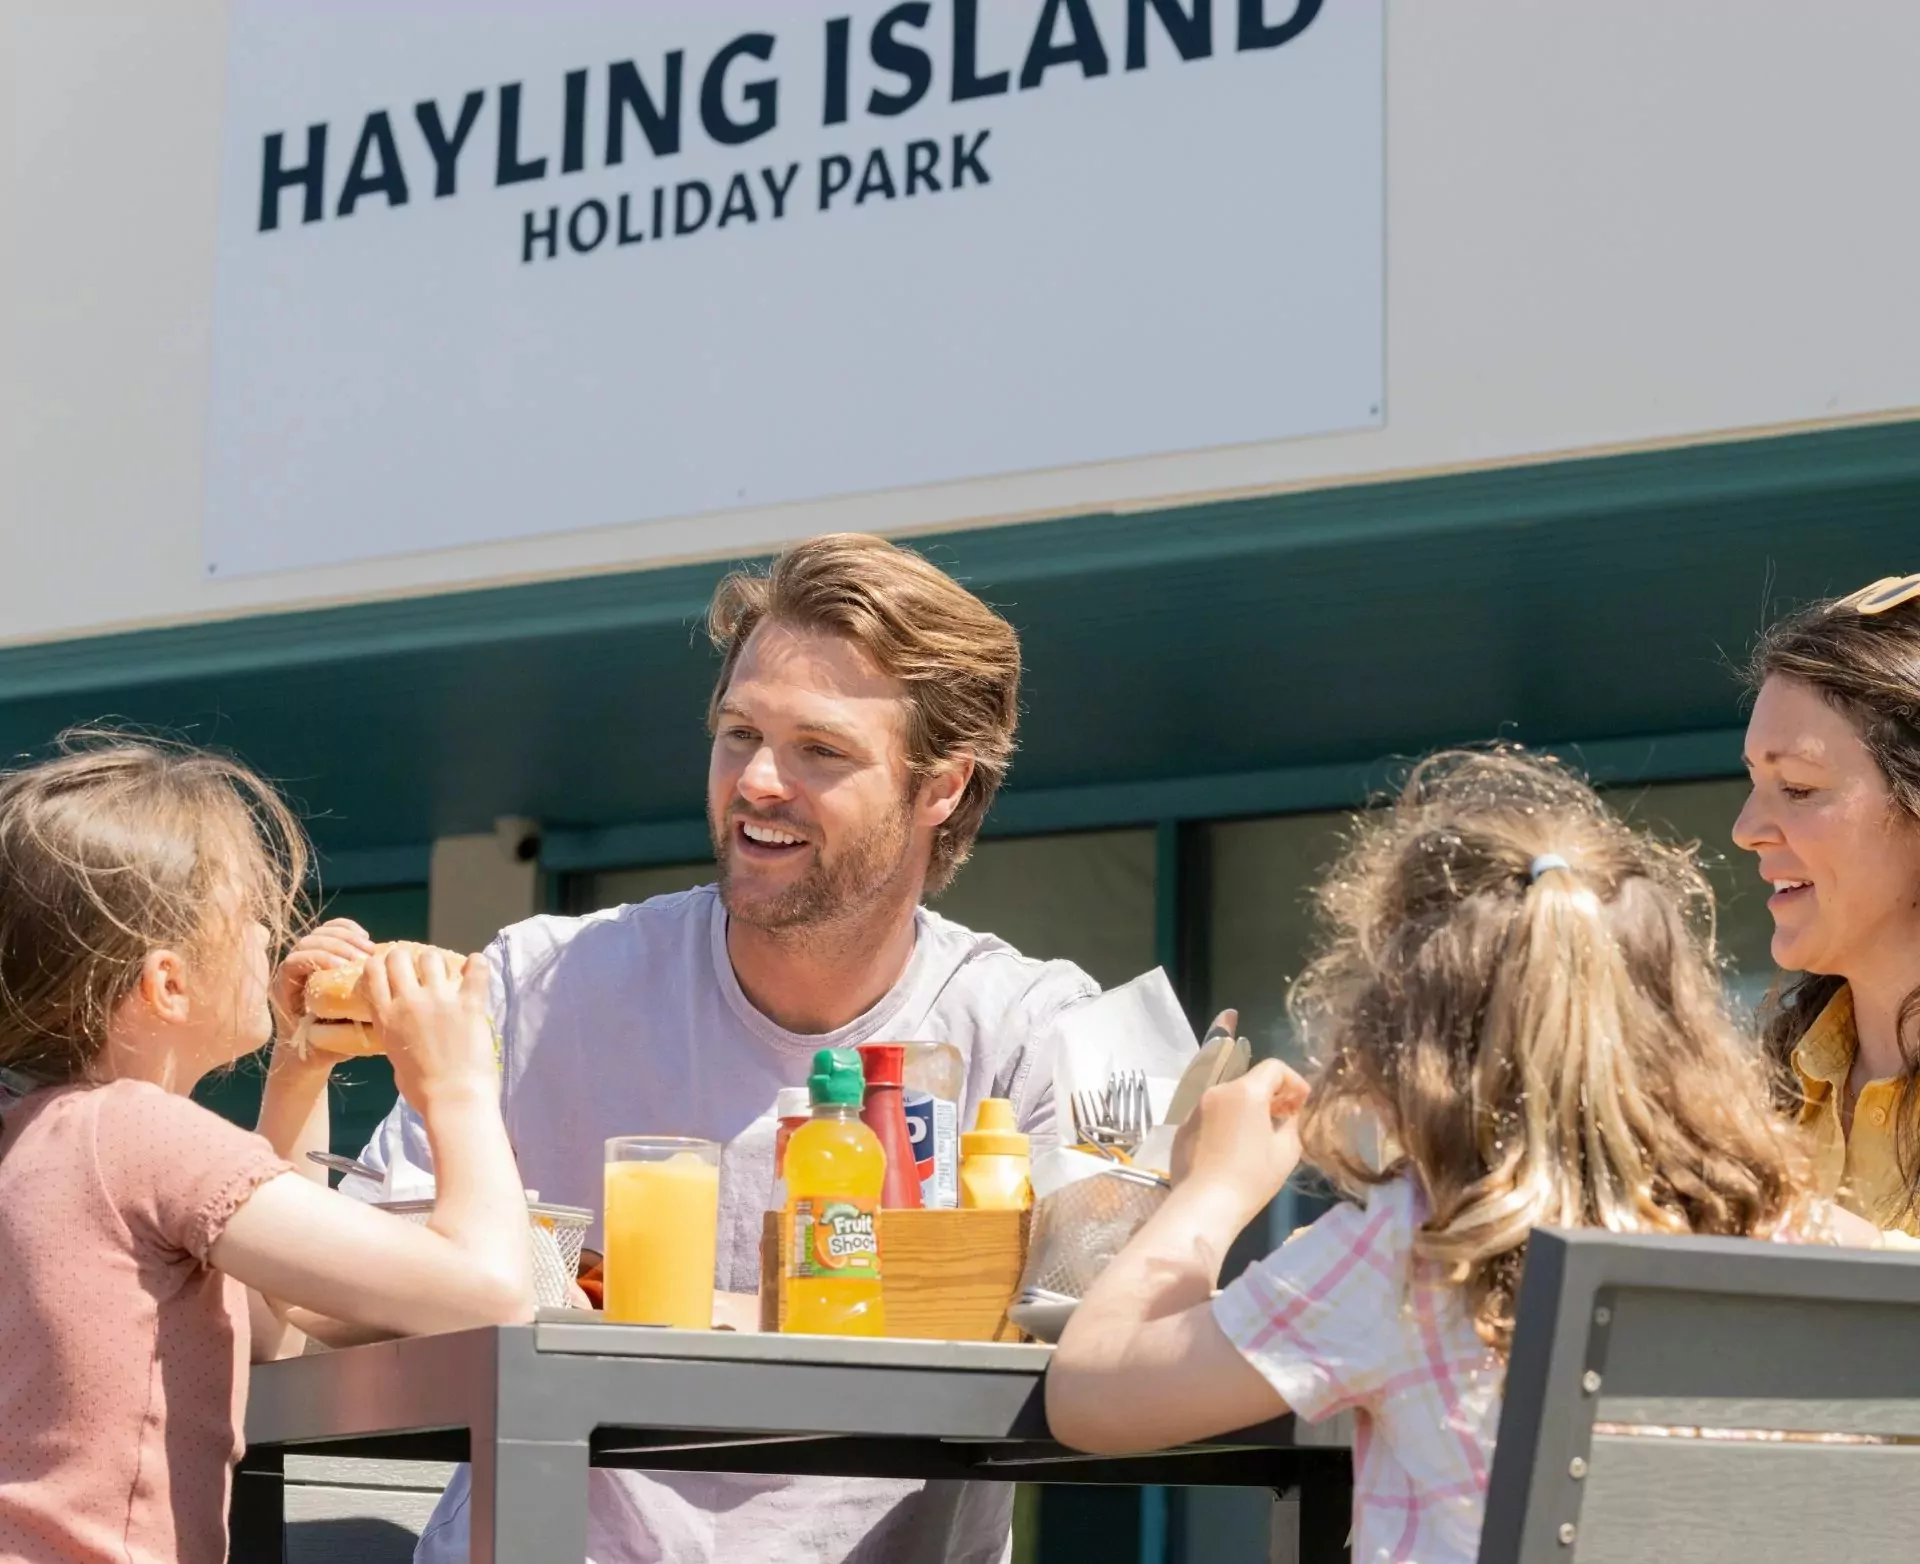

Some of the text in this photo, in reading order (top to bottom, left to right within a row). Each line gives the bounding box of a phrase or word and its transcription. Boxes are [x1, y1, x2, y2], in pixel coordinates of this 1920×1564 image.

[258, 33, 778, 232] HAYLING
[523, 130, 990, 263] HOLIDAY PARK
[834, 1213, 872, 1235] Fruit
